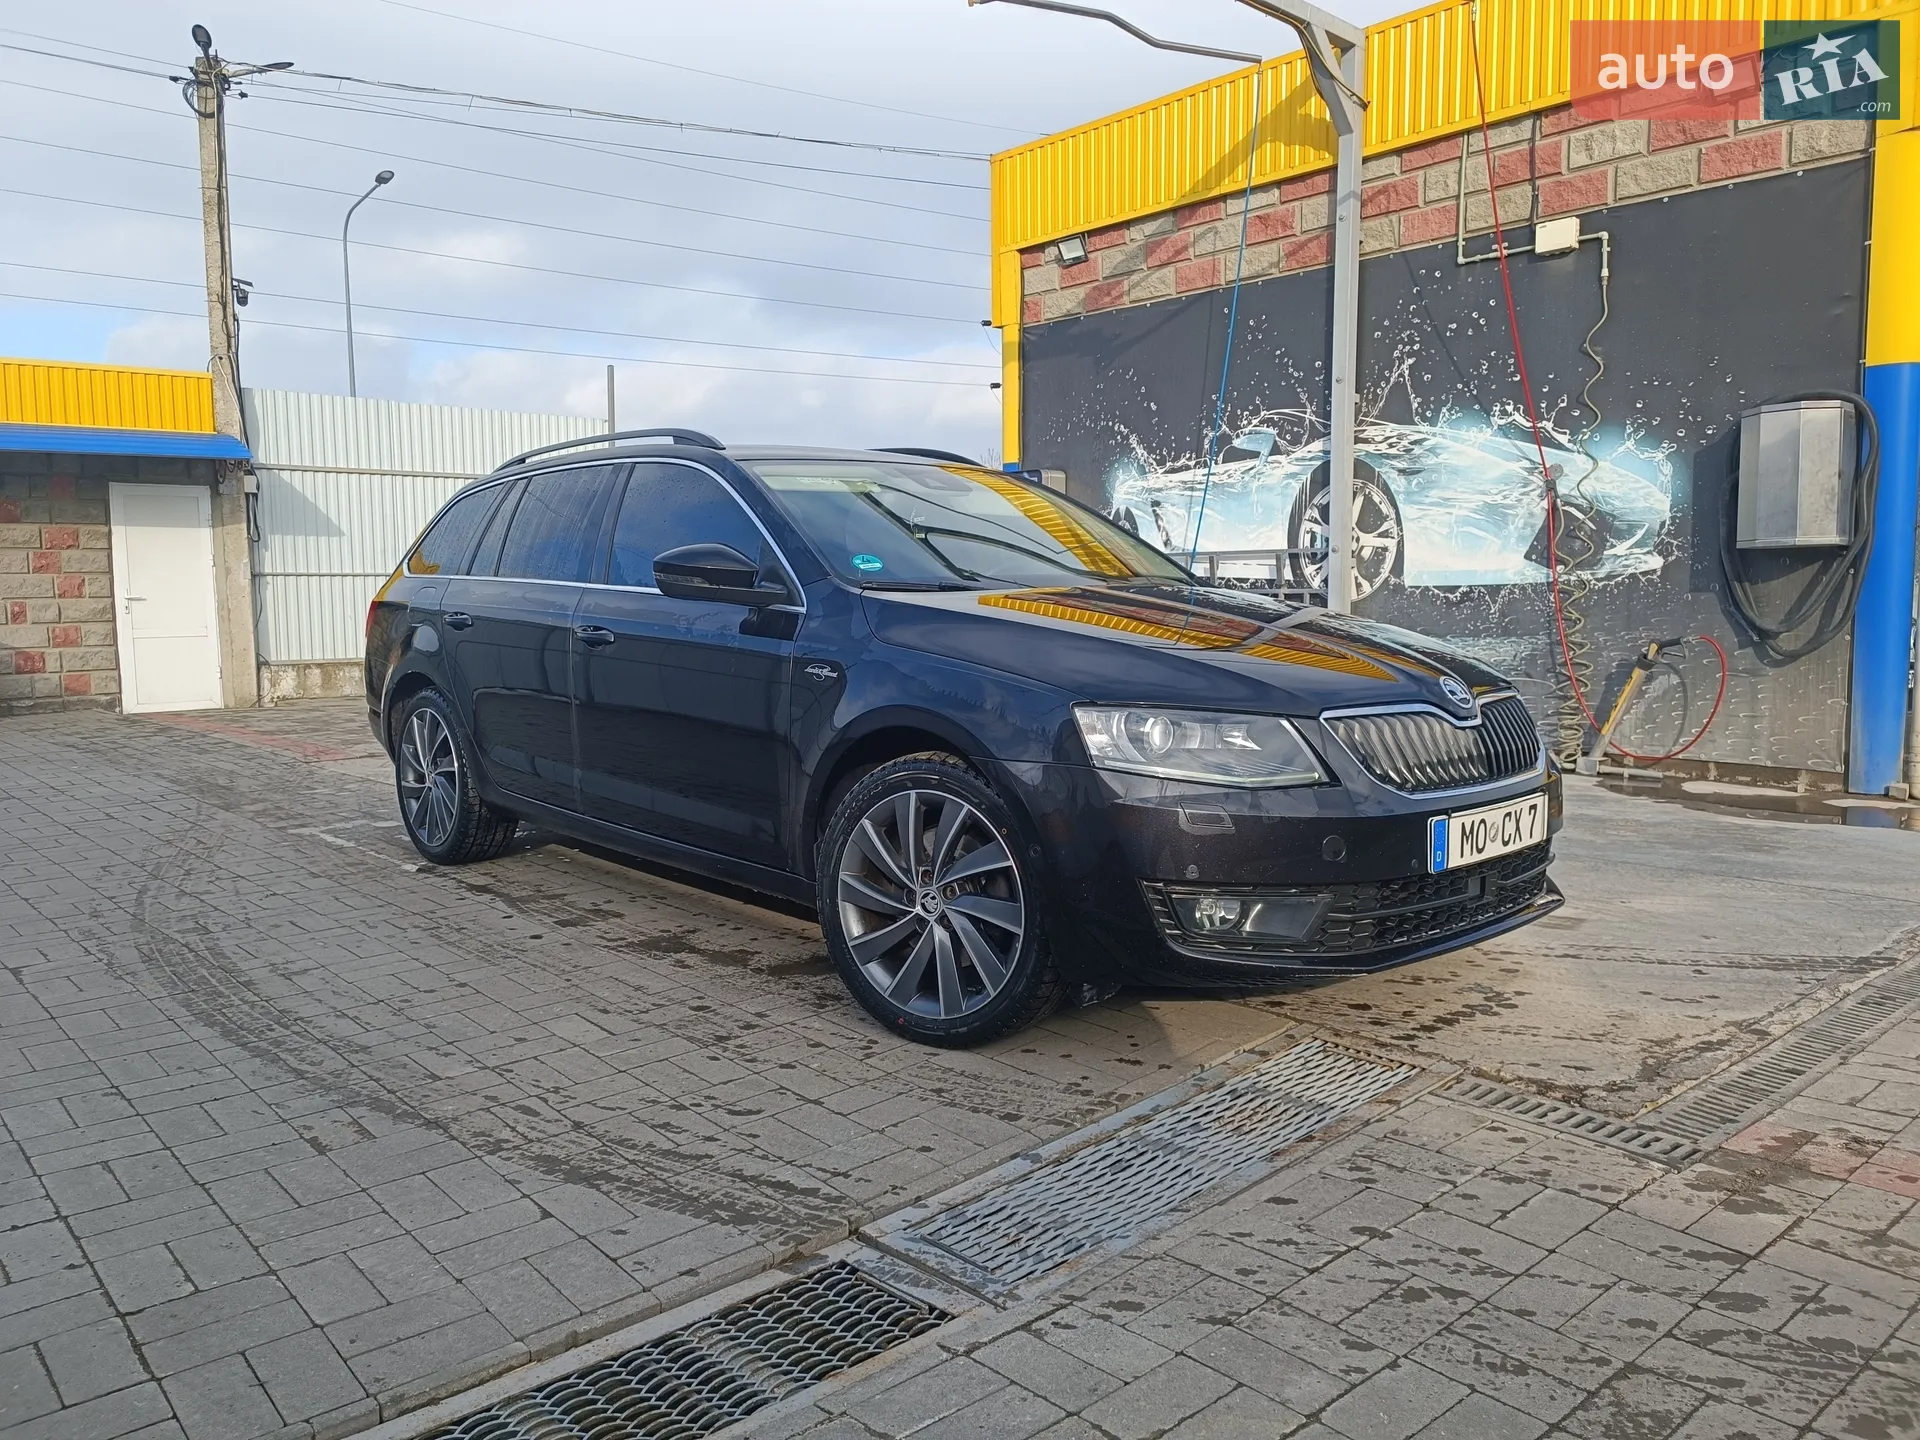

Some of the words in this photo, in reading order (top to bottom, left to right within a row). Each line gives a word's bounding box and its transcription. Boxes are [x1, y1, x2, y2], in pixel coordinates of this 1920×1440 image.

[1460, 818, 1488, 859] MO
[1501, 806, 1523, 847] CX
[1528, 803, 1538, 840] 7
[1436, 850, 1442, 862] D
